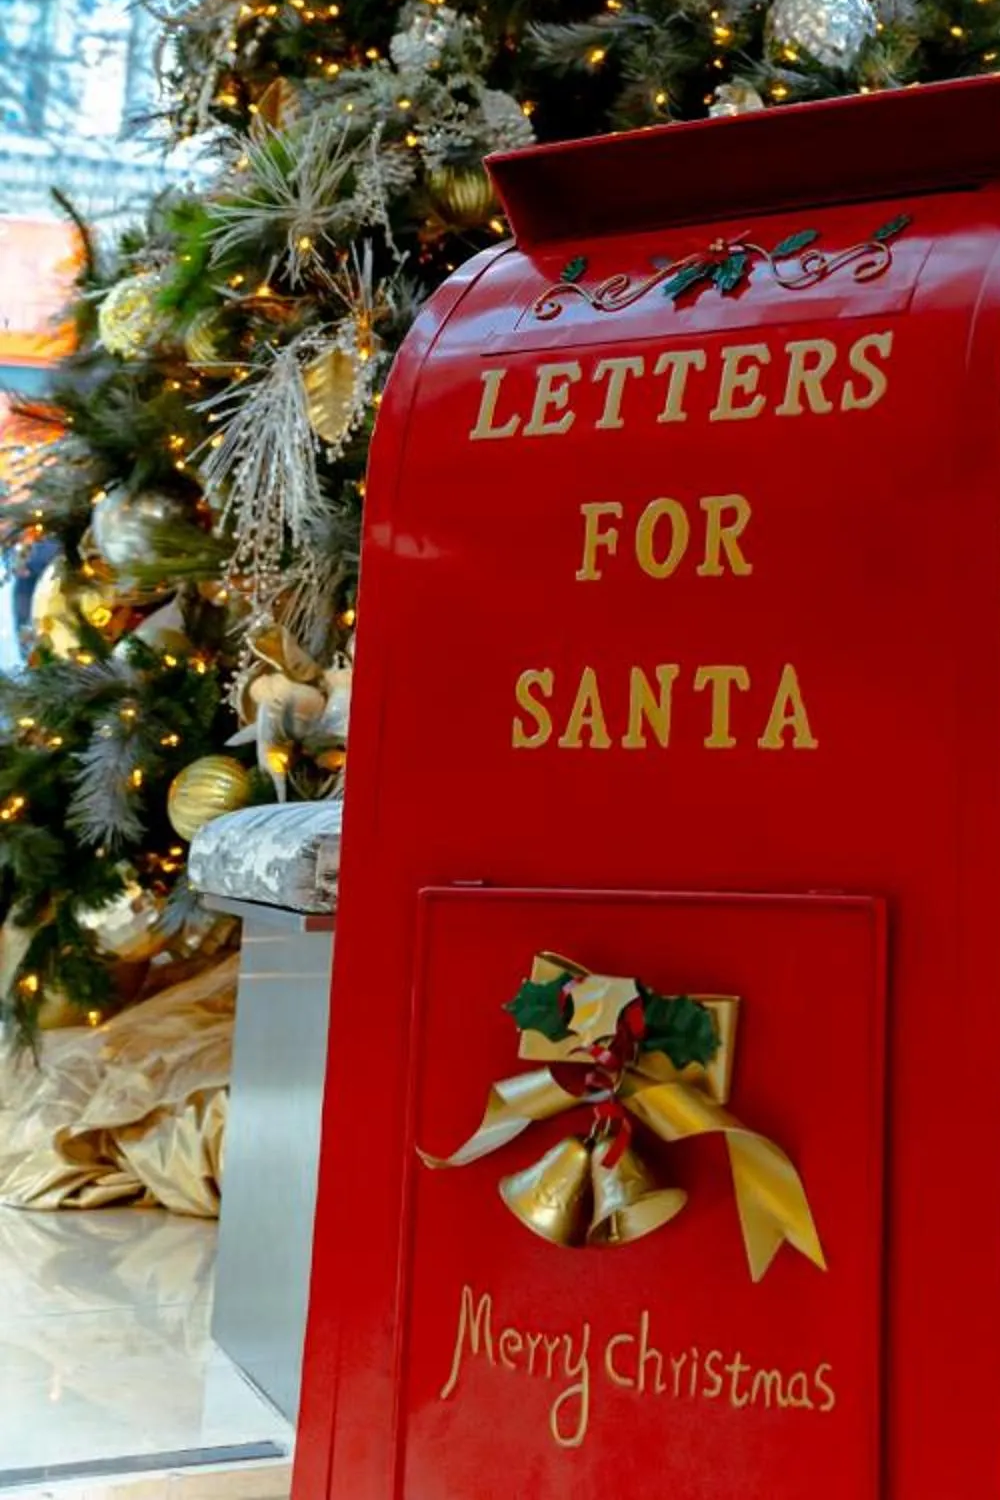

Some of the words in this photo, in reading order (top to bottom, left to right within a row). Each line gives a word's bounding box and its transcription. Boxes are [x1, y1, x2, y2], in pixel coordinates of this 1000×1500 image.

[469, 330, 894, 441] LETTERS
[575, 494, 752, 581] FOR
[512, 663, 819, 749] SANTA
[440, 1285, 591, 1447] Merry
[605, 1311, 835, 1412] Christmas
